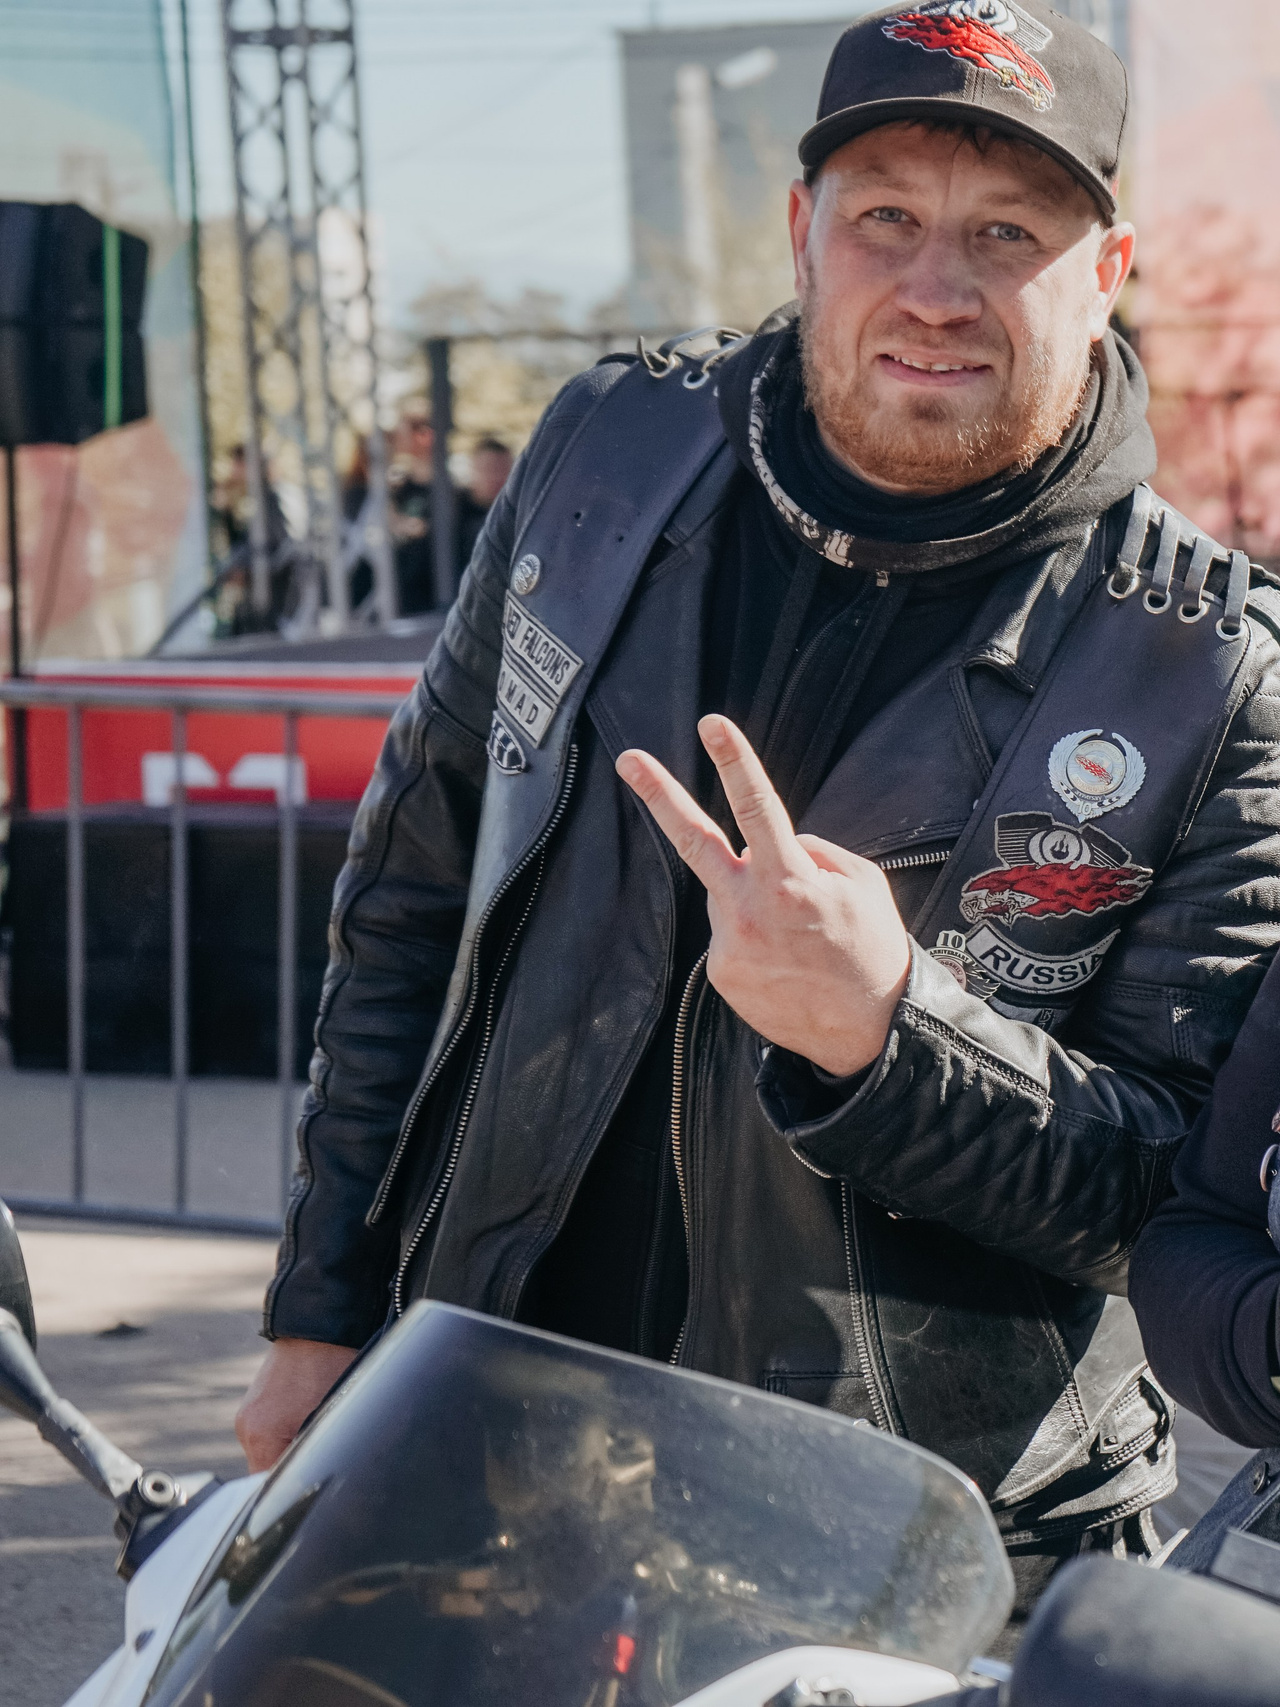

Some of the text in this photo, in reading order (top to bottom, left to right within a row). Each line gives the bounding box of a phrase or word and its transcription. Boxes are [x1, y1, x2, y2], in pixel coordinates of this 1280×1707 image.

[519, 625, 571, 686] FALCONS
[498, 671, 540, 725] OMAD
[930, 949, 969, 963] ANNIVERSARY
[940, 932, 963, 949] 10
[979, 942, 1104, 985] RUSSIA
